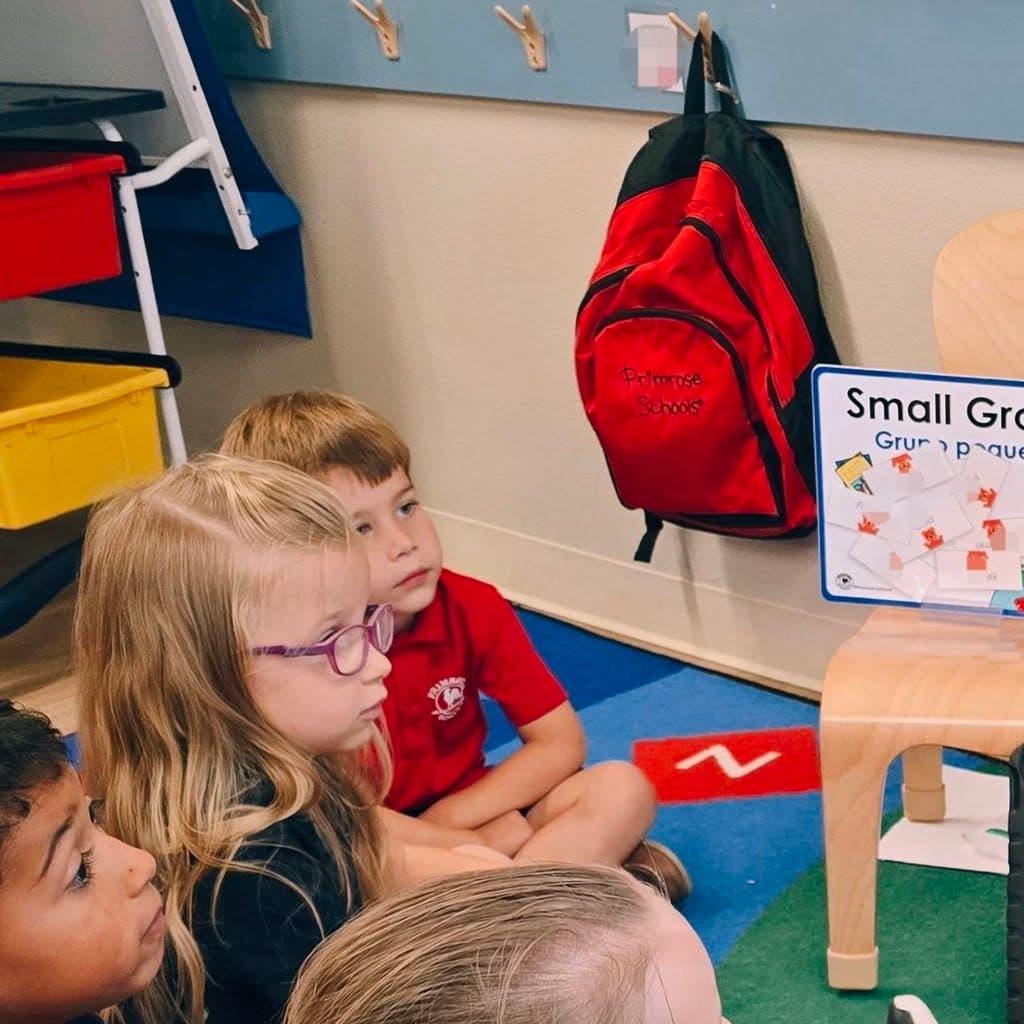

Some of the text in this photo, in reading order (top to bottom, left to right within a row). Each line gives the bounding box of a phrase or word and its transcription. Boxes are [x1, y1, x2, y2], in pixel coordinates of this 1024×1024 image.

[620, 367, 703, 388] Primrose
[638, 395, 701, 416] Schools
[847, 387, 951, 425] Small
